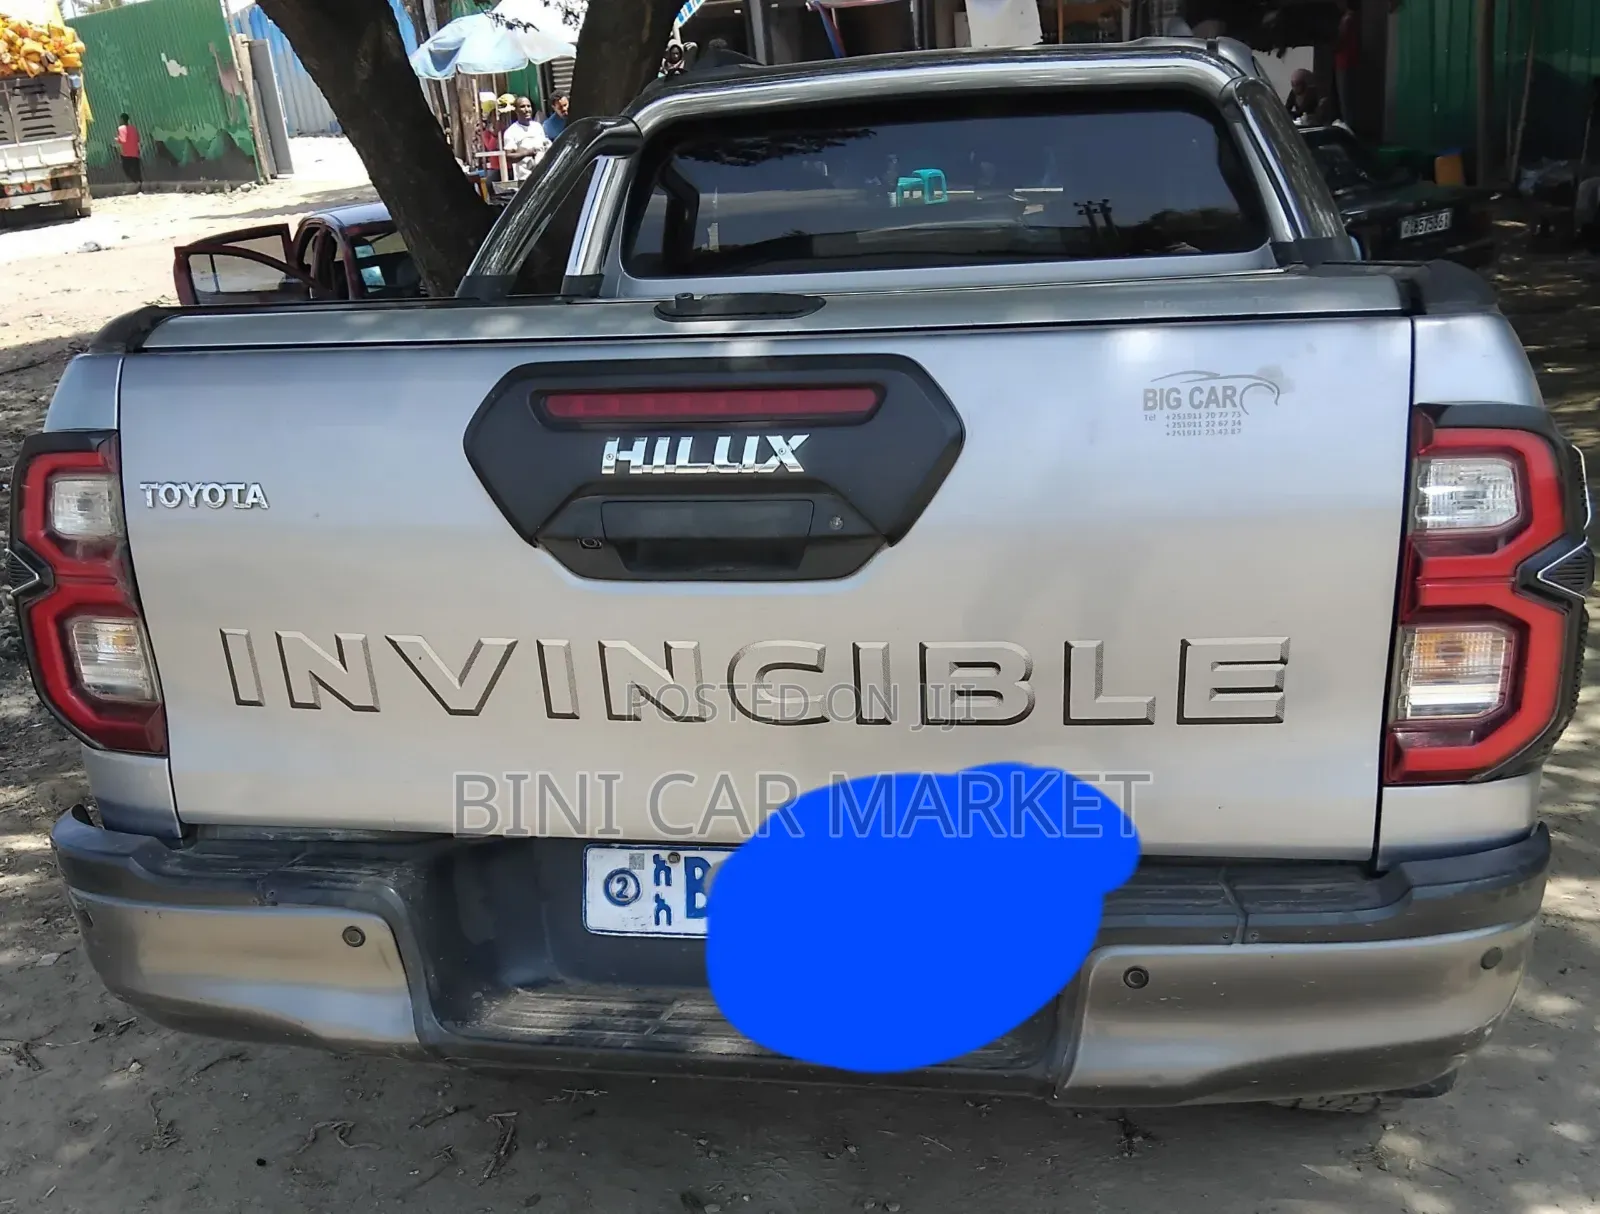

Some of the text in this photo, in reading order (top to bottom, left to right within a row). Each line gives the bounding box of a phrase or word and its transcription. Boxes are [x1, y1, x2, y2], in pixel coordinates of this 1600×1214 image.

[1143, 385, 1238, 411] BIG CAR
[601, 434, 810, 475] HILUX
[140, 482, 270, 509] TOYOTA
[220, 627, 1291, 726] INVINCIBLE
